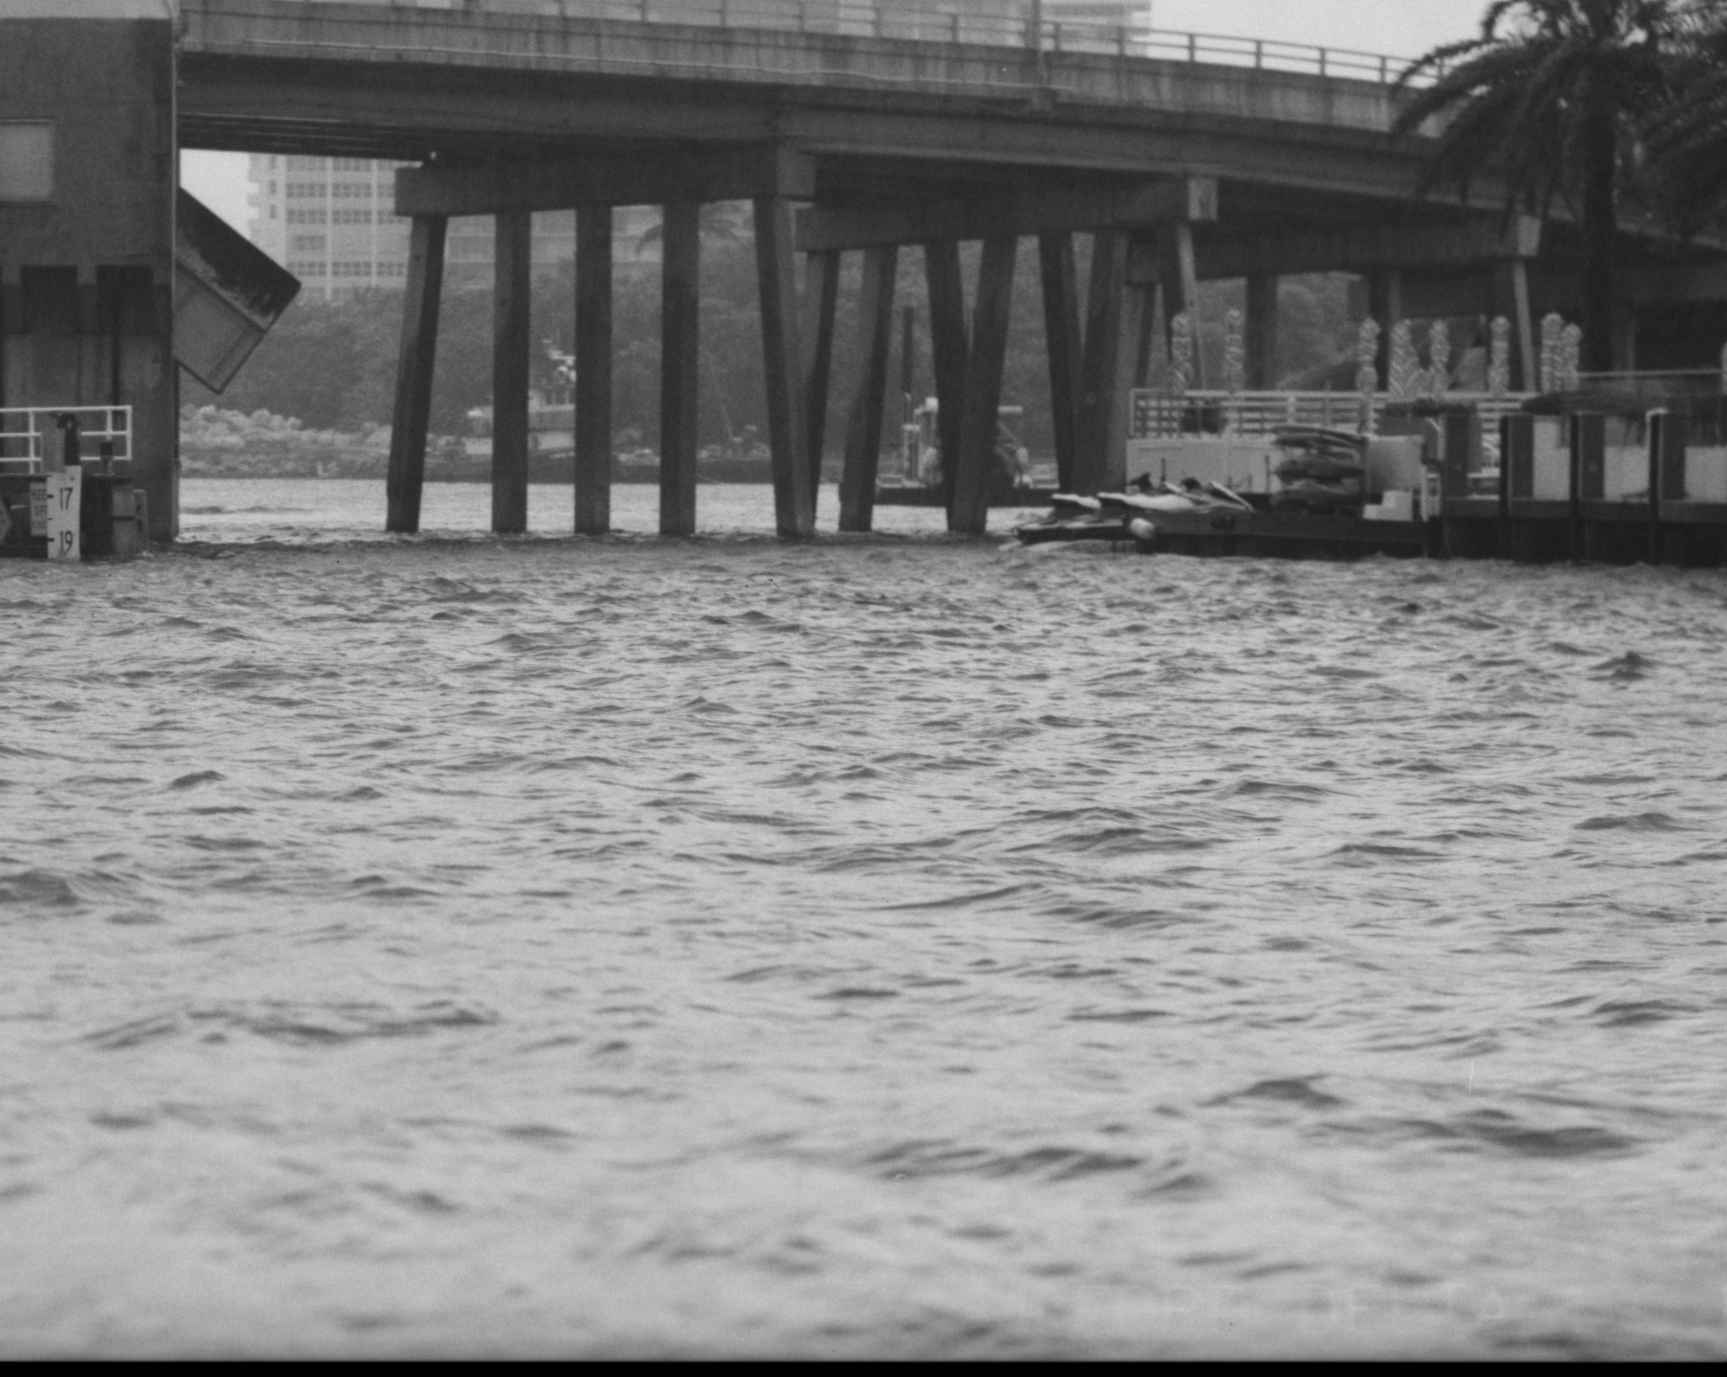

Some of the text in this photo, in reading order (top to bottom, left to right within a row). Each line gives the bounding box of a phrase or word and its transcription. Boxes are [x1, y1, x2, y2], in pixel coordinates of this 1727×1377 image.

[32, 489, 47, 501] KEE
[59, 487, 74, 510] 17
[59, 530, 74, 556] 19
